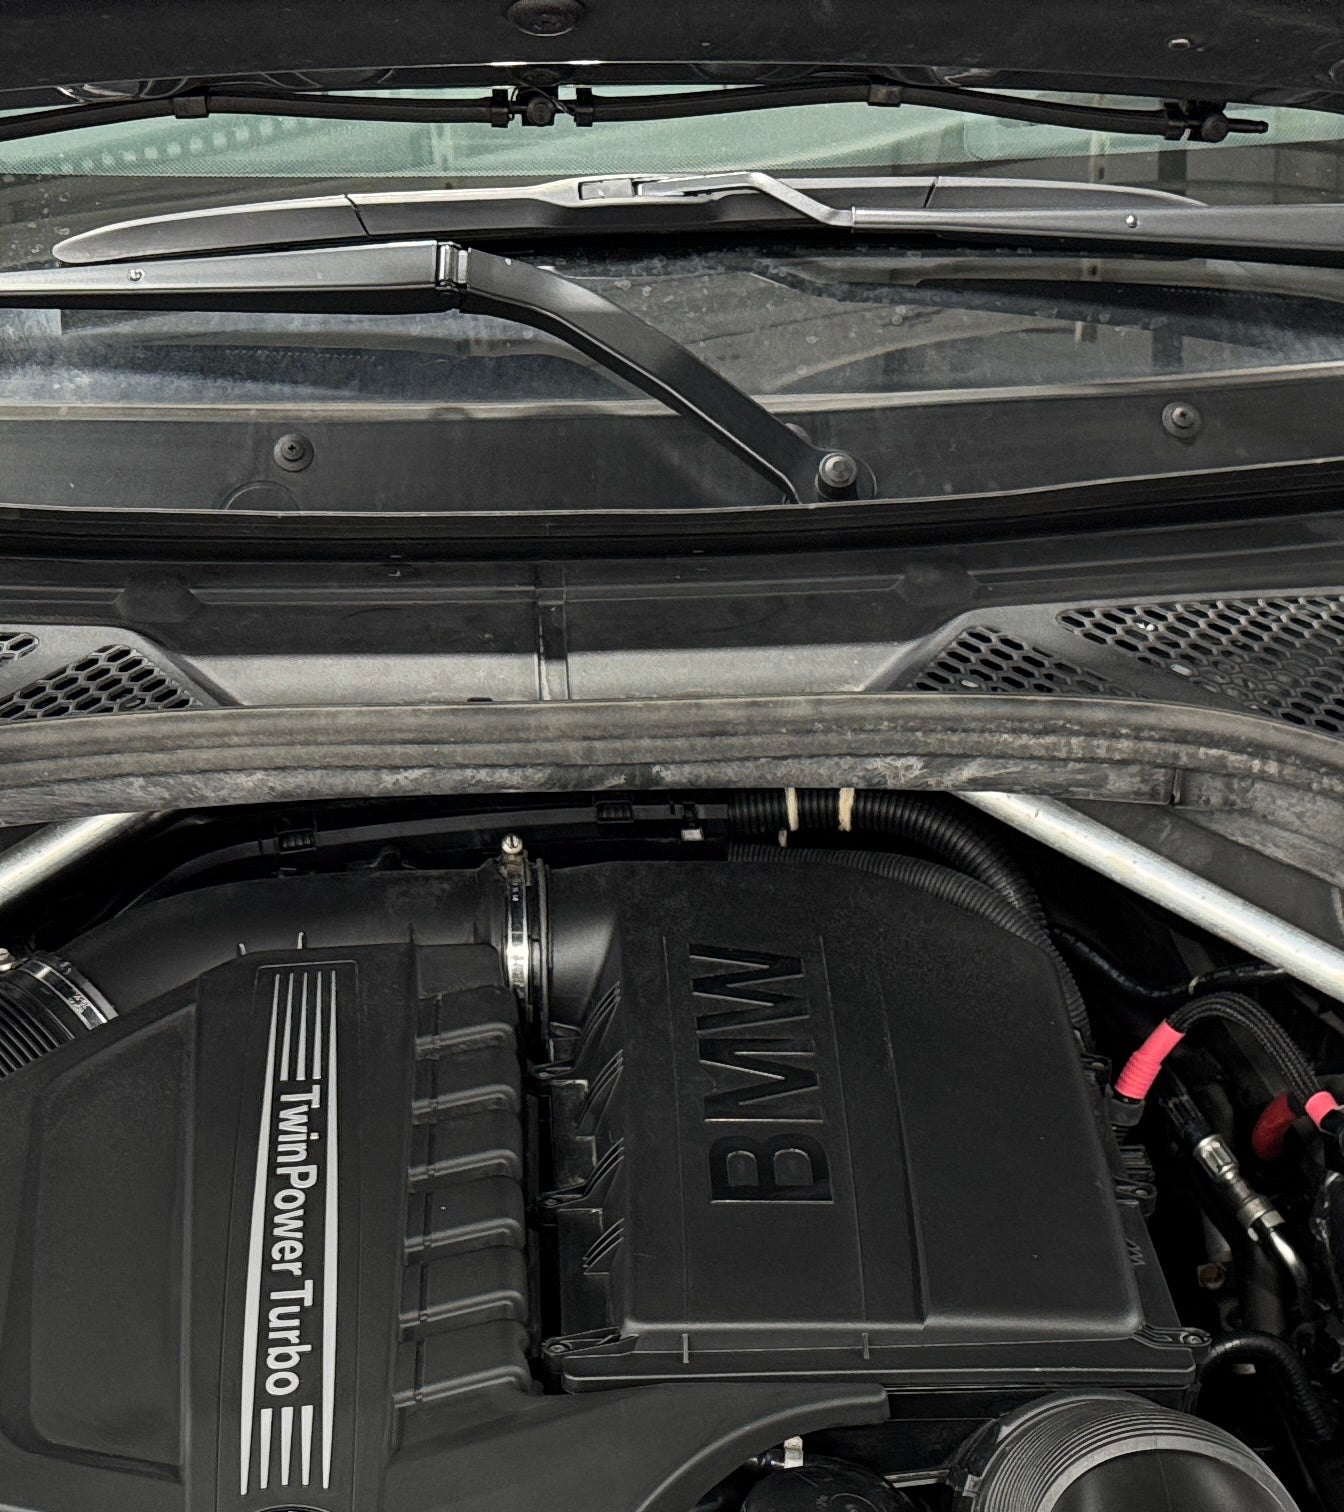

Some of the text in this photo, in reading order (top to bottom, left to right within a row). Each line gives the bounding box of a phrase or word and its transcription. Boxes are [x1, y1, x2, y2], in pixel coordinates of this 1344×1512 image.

[688, 943, 834, 1204] BMW
[264, 1084, 321, 1396] TwinPower Turbo
